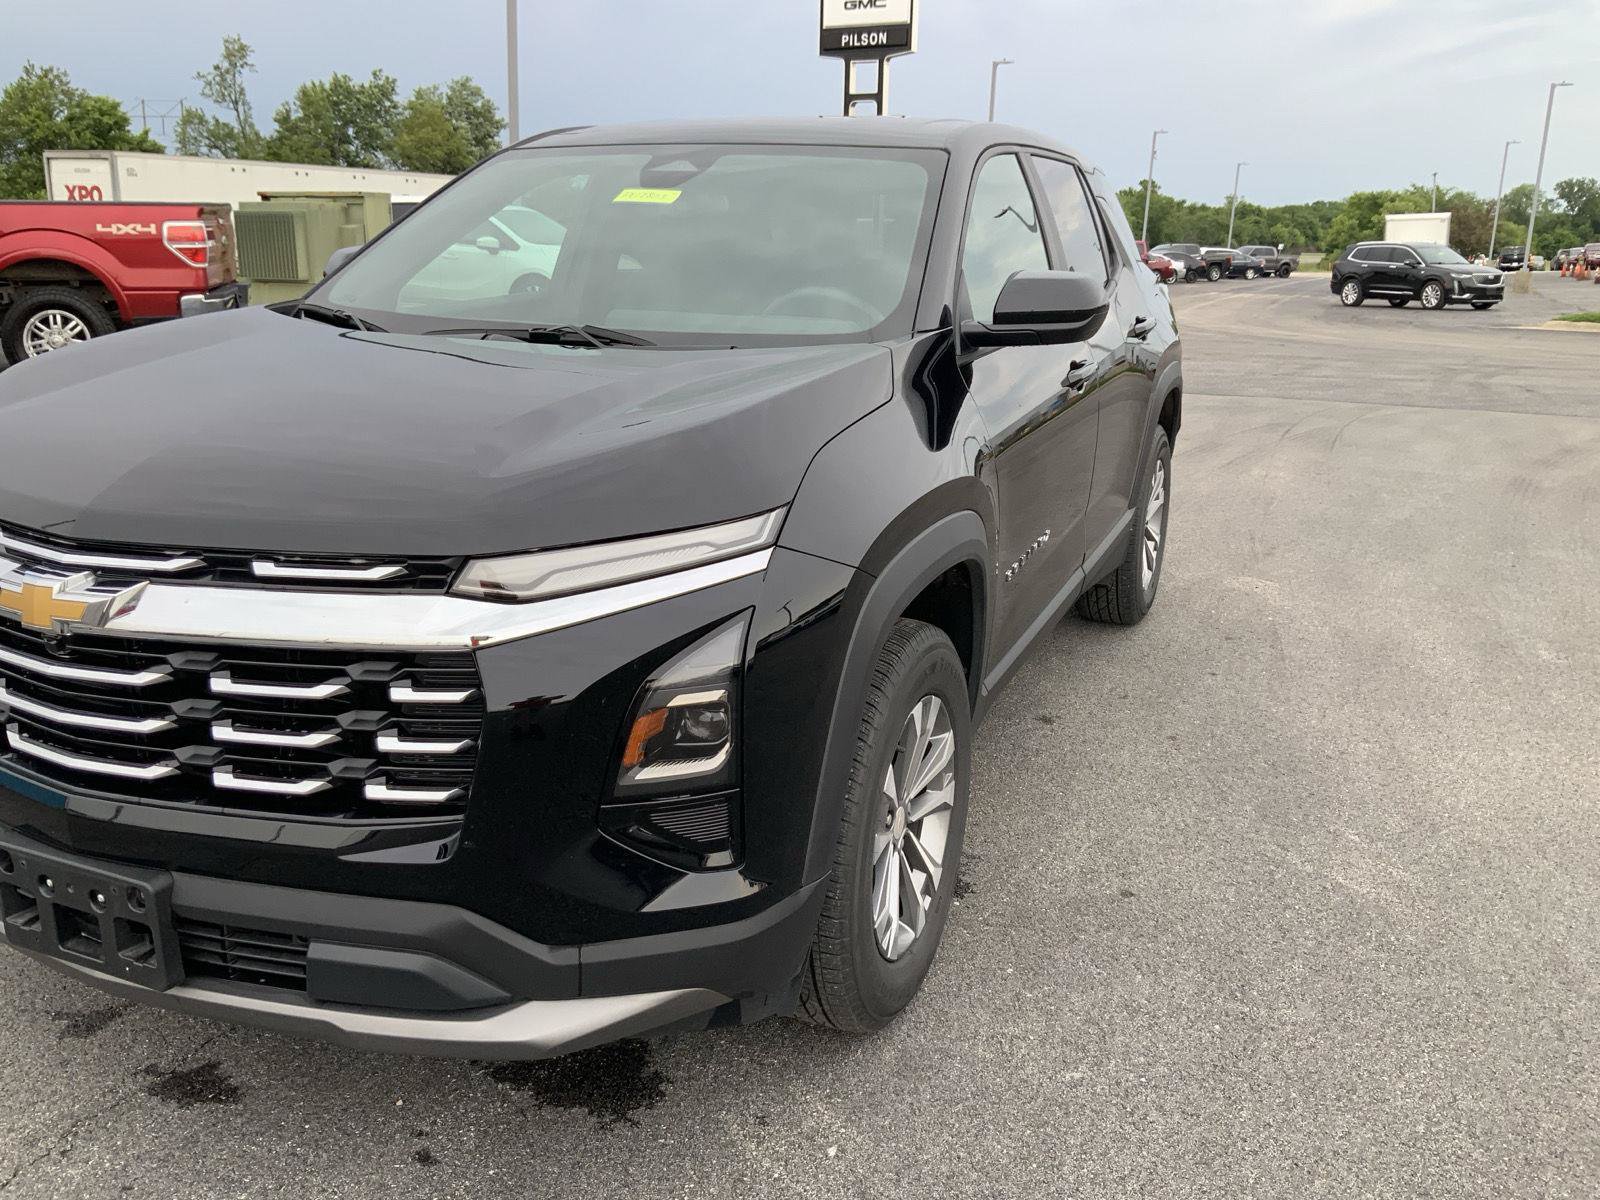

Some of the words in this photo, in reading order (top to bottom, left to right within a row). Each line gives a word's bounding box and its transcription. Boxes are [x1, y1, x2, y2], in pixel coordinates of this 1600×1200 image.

[844, 0, 887, 10] GMC
[842, 31, 887, 47] PILSON
[64, 184, 103, 201] XPO
